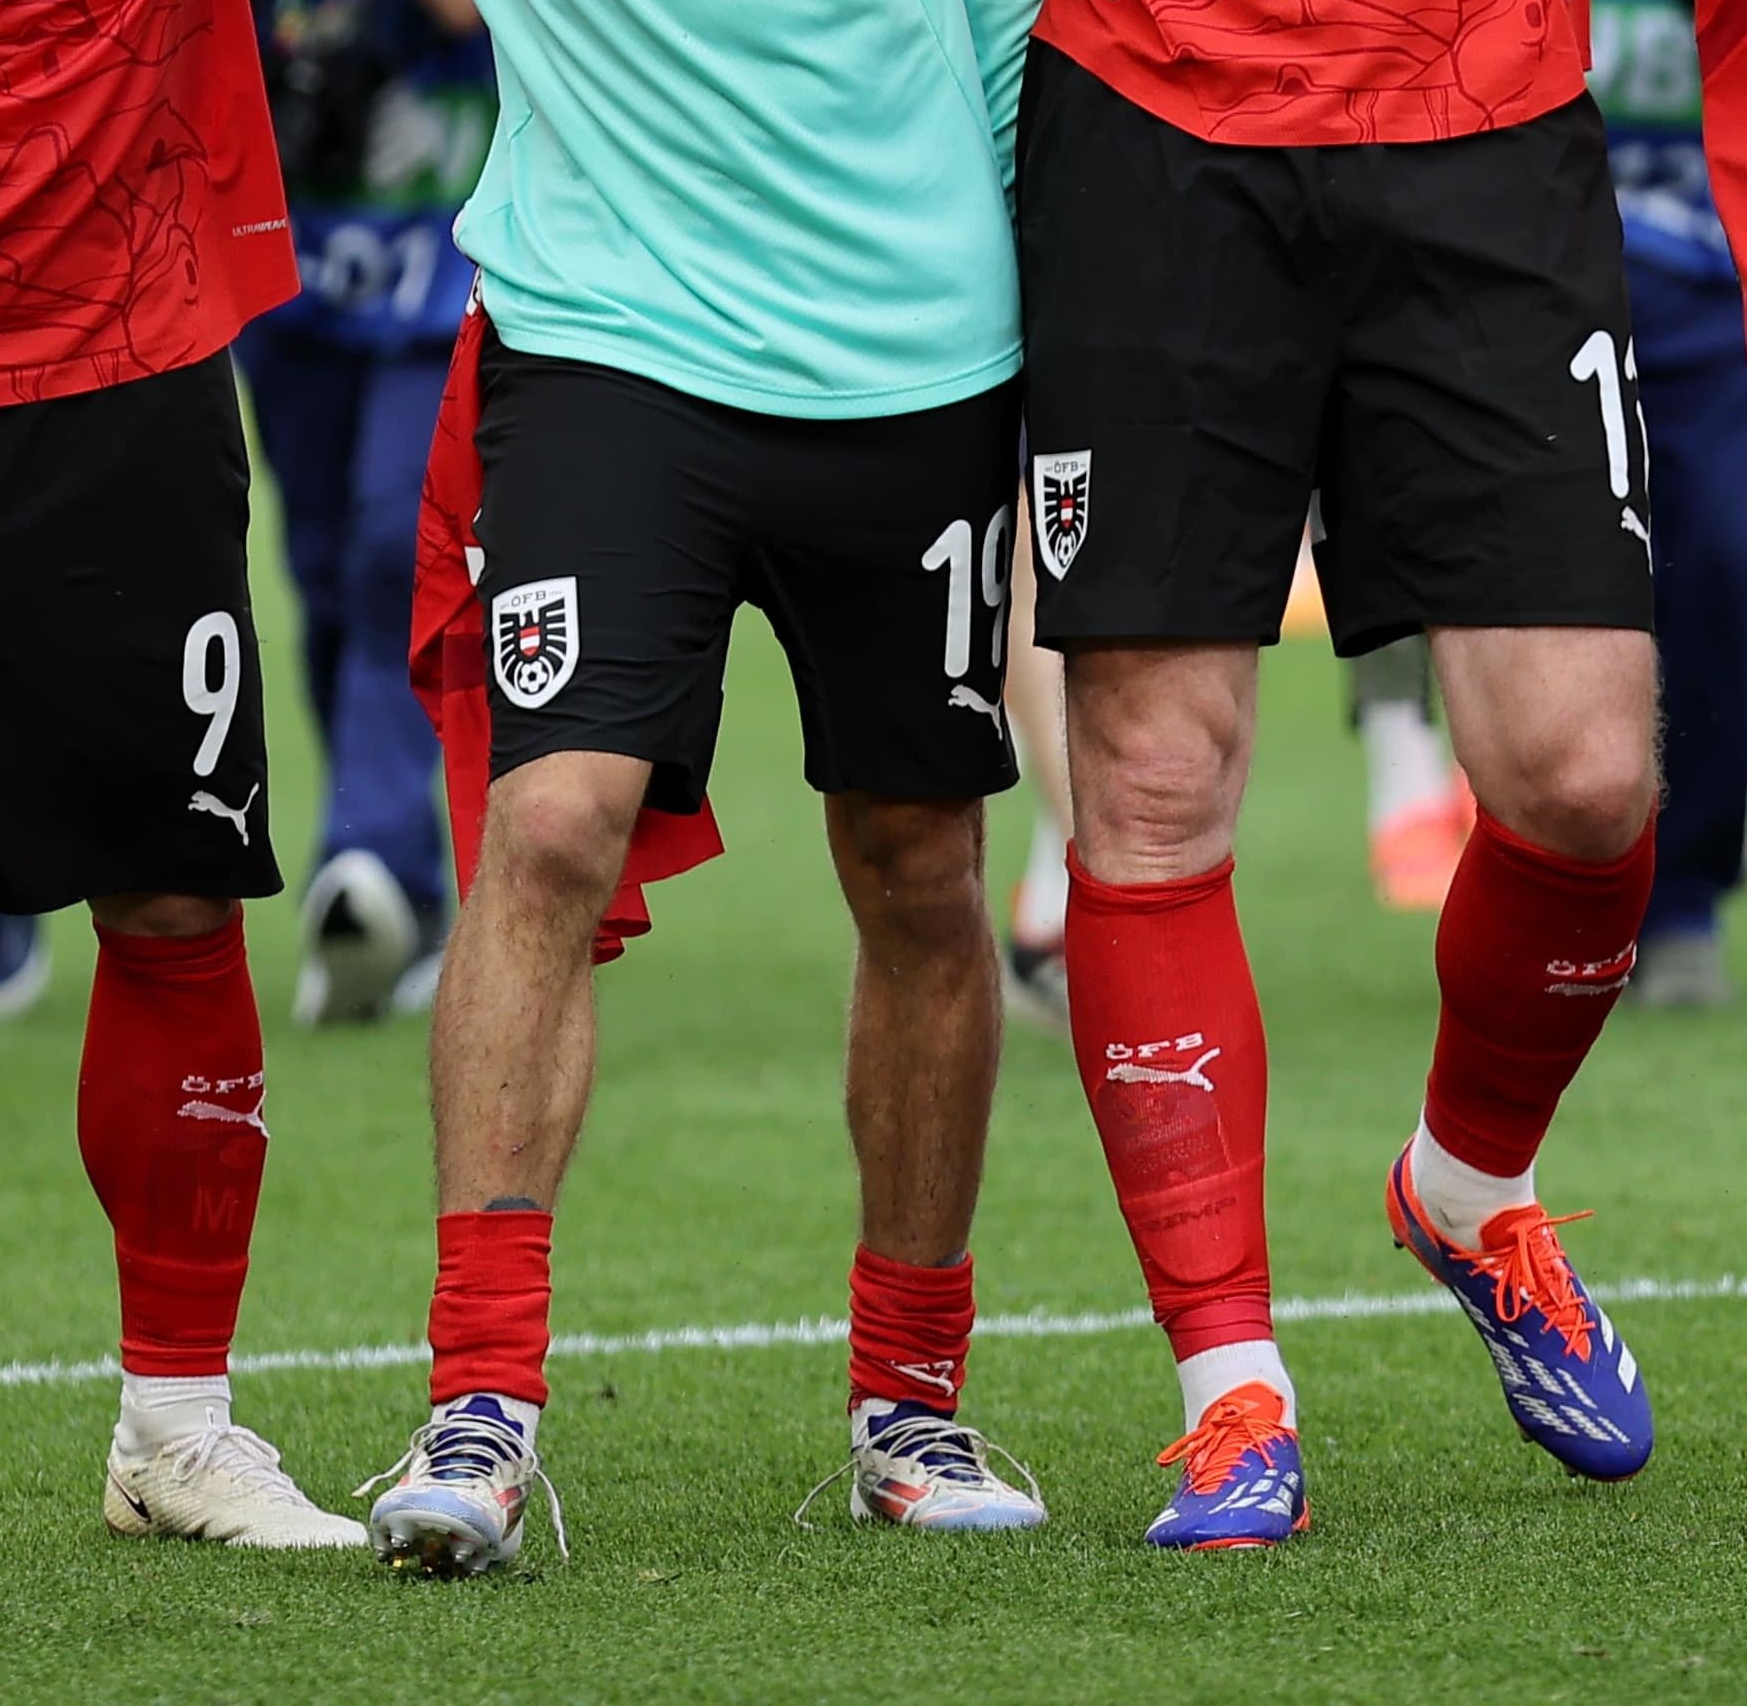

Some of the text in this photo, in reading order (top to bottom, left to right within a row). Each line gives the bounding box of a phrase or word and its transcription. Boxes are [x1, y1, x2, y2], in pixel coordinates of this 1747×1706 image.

[921, 504, 1011, 678] 19
[182, 610, 241, 776] 9
[1106, 1032, 1204, 1060] ÖFB
